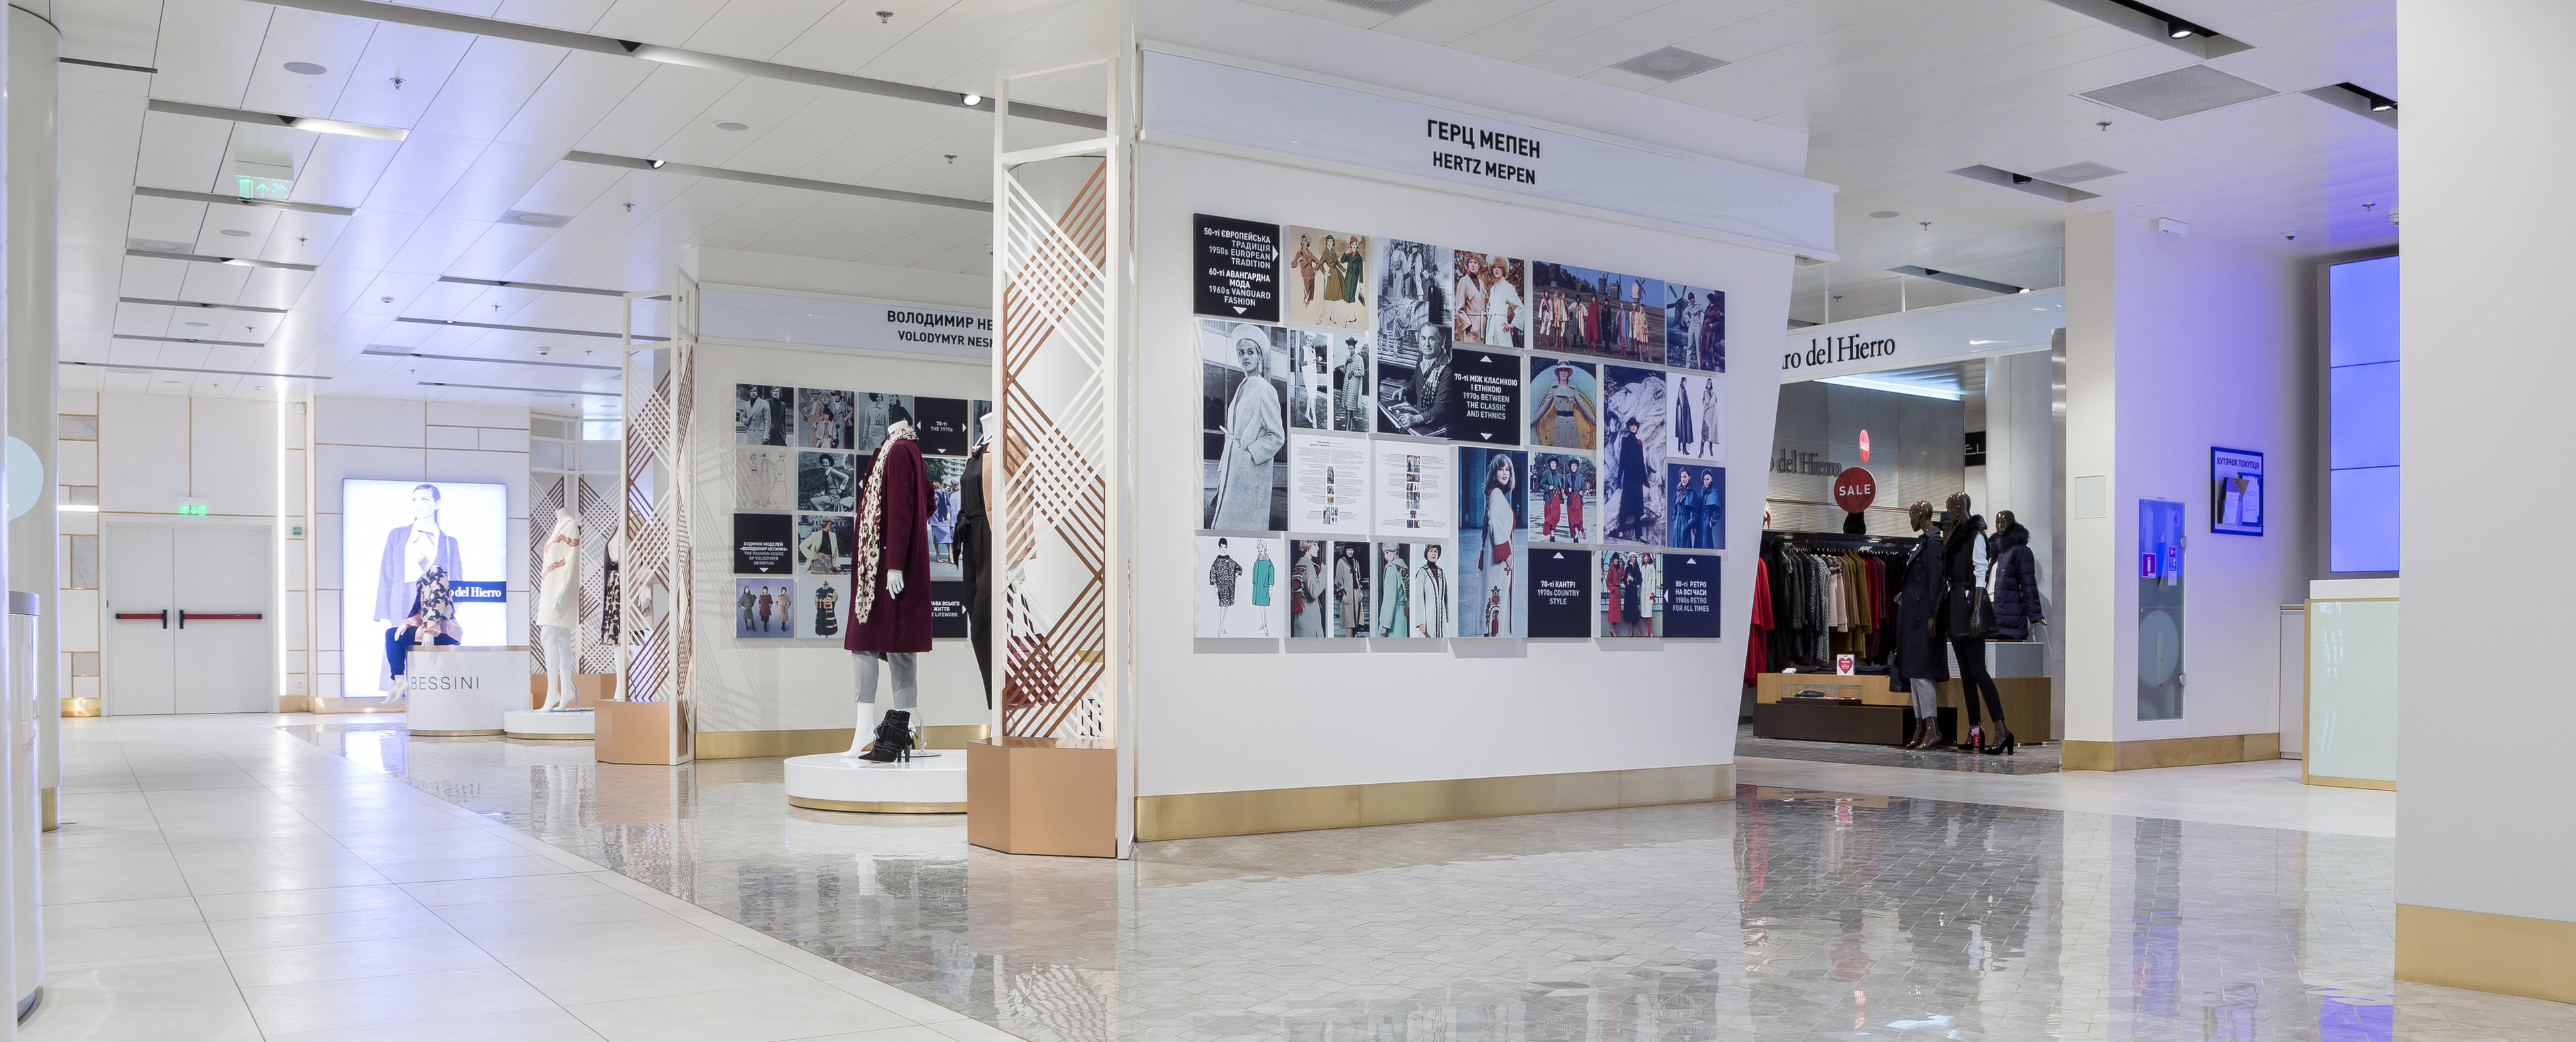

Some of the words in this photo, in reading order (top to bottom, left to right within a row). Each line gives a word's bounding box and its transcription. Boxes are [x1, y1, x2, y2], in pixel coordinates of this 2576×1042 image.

[1428, 119, 1474, 150] ГЕРЦ
[1480, 129, 1540, 159] МЕПЕН
[1433, 151, 1481, 175] HERTZ
[1485, 161, 1536, 185] MEPEN
[1204, 227, 1220, 237] 50-ті
[1221, 229, 1271, 243] ЄВРОПЕЙСЬКА
[1232, 239, 1271, 252] ТРАДИЦІЯ
[1209, 245, 1228, 255] 1950s
[1231, 249, 1271, 260] EUROPEAN
[1231, 257, 1271, 269] TRADITION
[1209, 268, 1225, 276] 60-ті
[1226, 270, 1271, 282] АВАНГАРДНА
[1230, 279, 1250, 289] МОДА
[1209, 286, 1230, 294] 1960s
[1231, 288, 1271, 299] VANGUARD
[1224, 296, 1256, 306] FASHION
[888, 310, 973, 328] ВОЛОДИМИР
[898, 330, 965, 345] VOLODYMYR
[1782, 352, 1801, 369] ro
[1806, 337, 1833, 366] del
[1837, 333, 1895, 362] Hierro
[1454, 373, 1468, 382] 70-ті
[1470, 375, 1483, 383] МІЖ
[1484, 377, 1517, 386] КЛАСИКОЮ
[1474, 384, 1501, 393] ЕТНІКОЮ
[1481, 394, 1509, 403] BETWEEN
[1481, 402, 1506, 411] CLASSIC
[1481, 411, 1506, 420] ETHNICS
[1777, 449, 1798, 473] del
[2216, 457, 2238, 467] КУТОЧОК
[2239, 460, 2259, 470] ПОКУПЦЯ
[1839, 484, 1871, 496] SALE
[455, 587, 469, 597] del
[470, 587, 502, 597] Hierro
[411, 676, 479, 690] BESSINI
